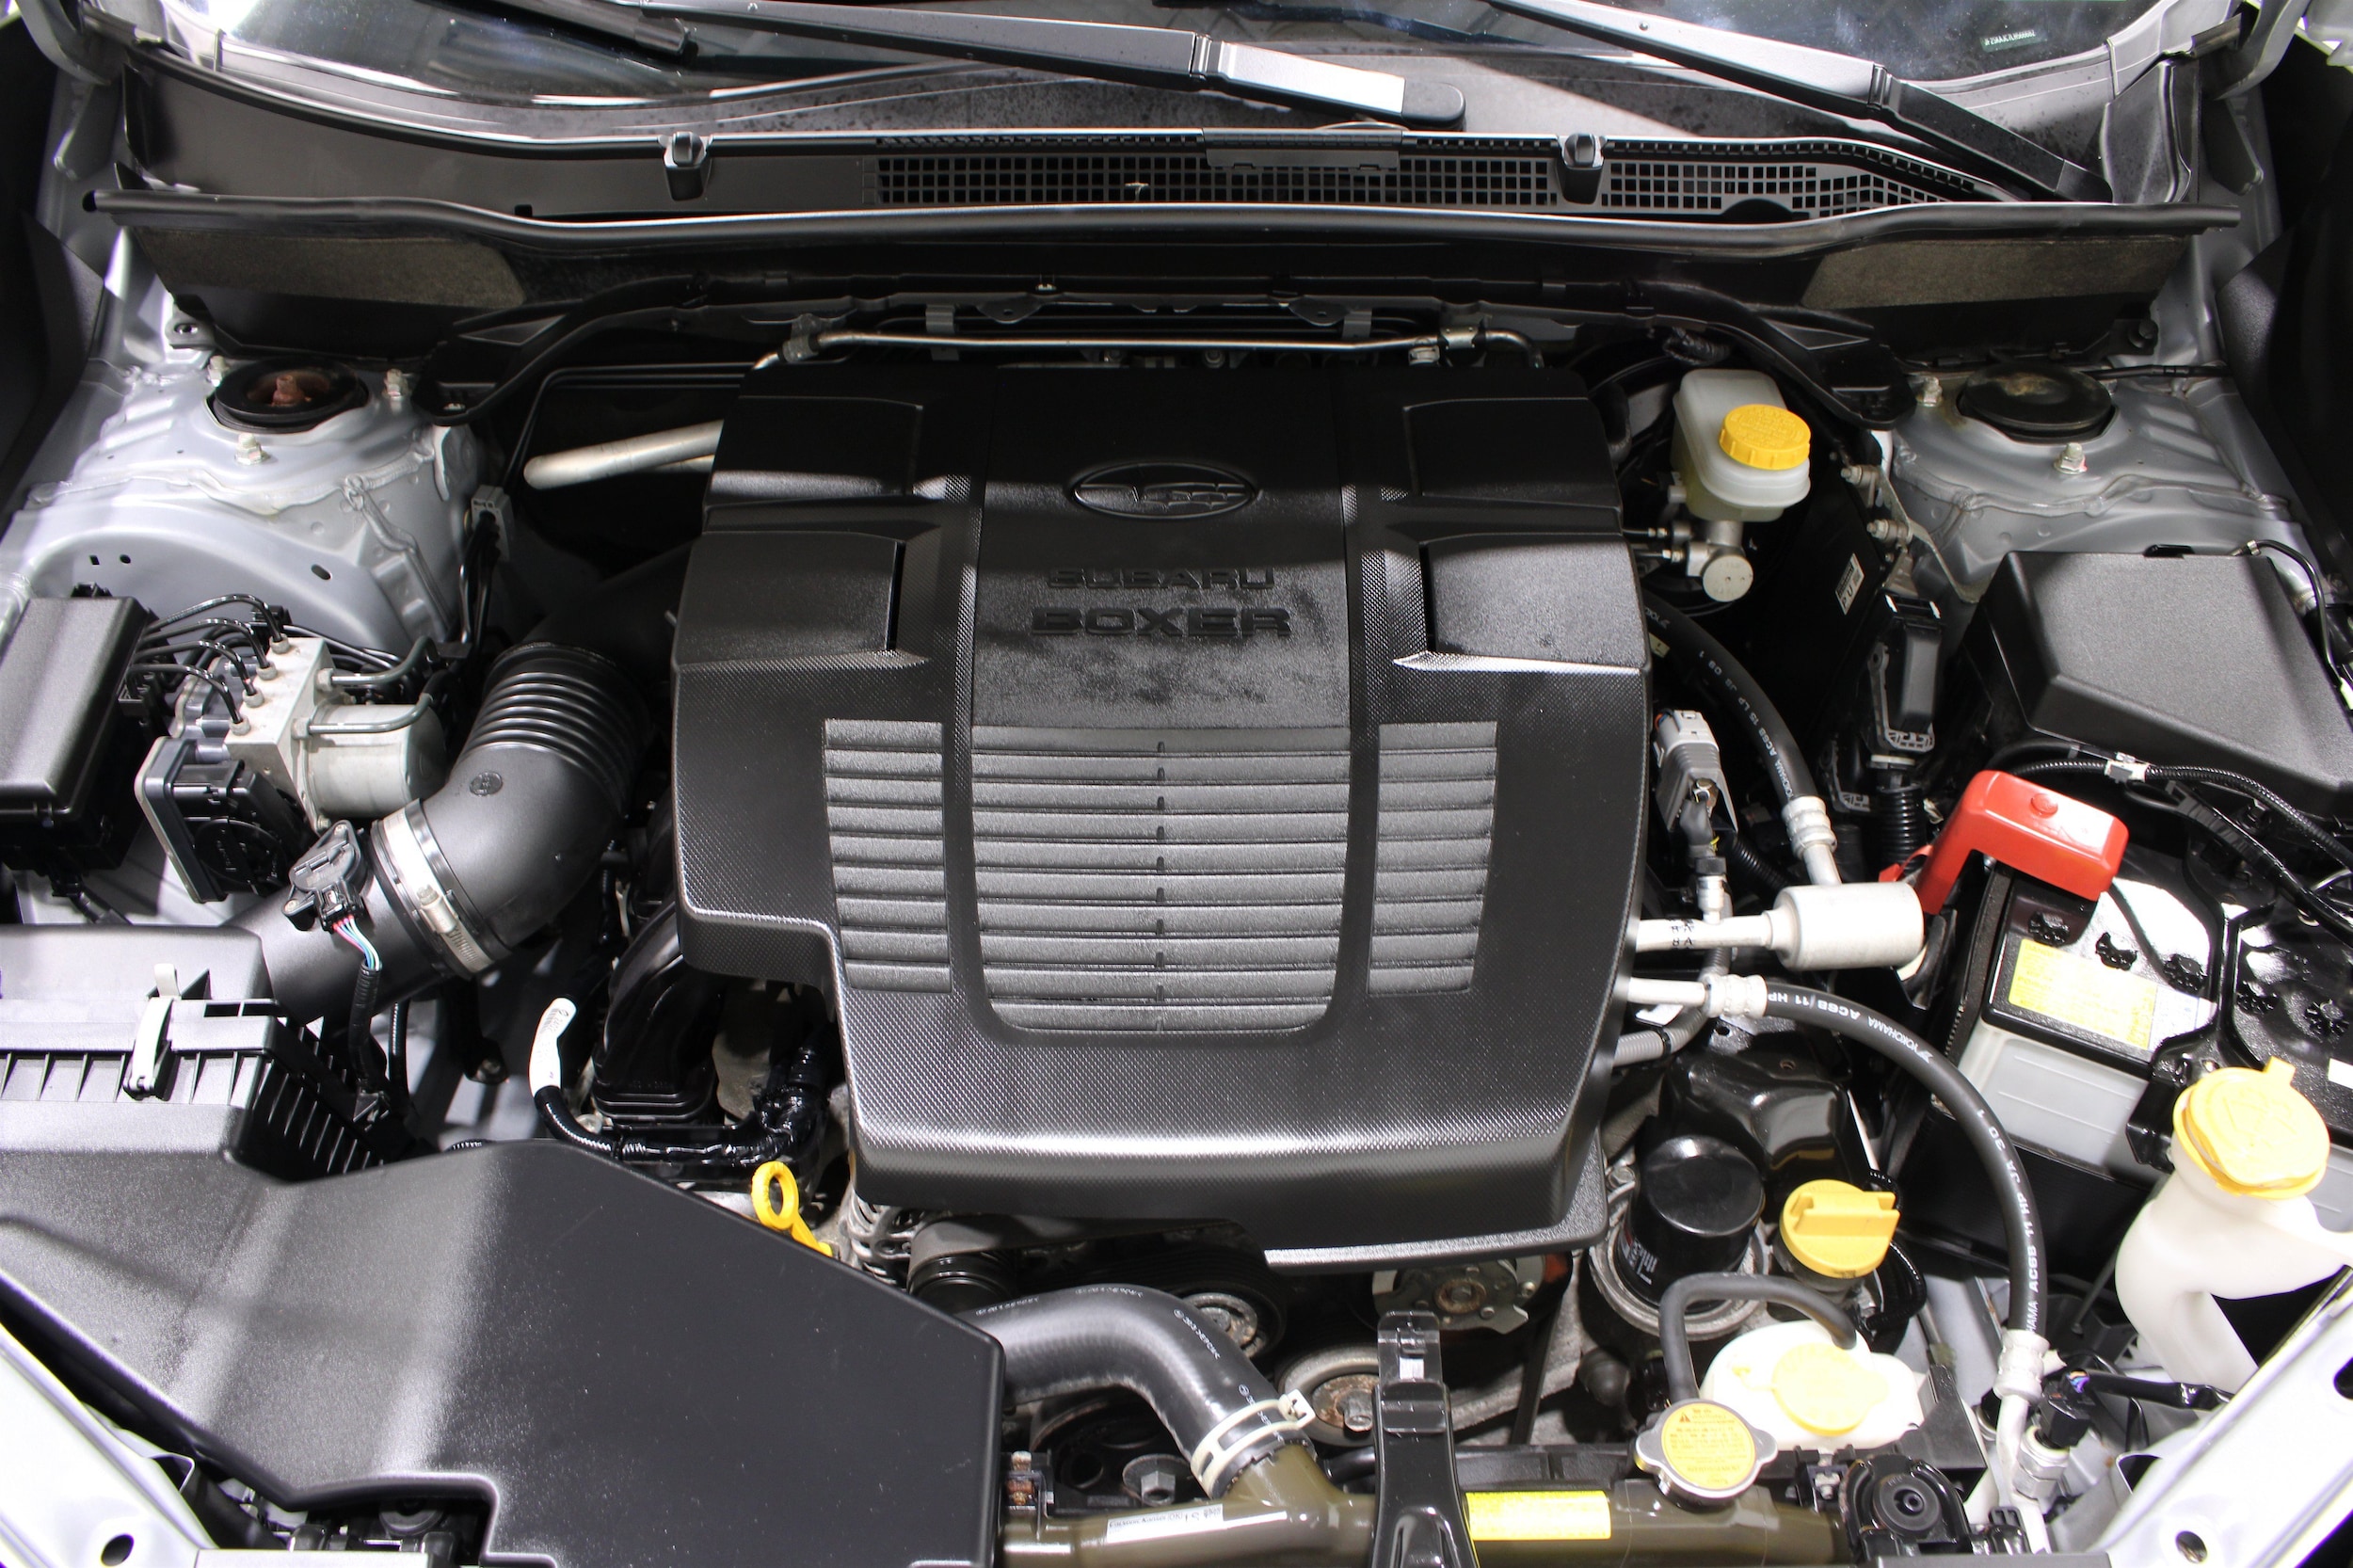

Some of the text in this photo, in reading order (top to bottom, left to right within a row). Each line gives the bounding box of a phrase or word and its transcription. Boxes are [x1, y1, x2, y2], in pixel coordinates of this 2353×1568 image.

[1048, 567, 1274, 589] SUBARU
[1032, 606, 1291, 637] BOXER
[1737, 696, 1751, 712] LP
[1749, 712, 1760, 726] 15
[1768, 992, 1788, 1003] HP
[1817, 1000, 1862, 1020] AC6B
[1867, 1015, 1919, 1053] YOKOHAMA
[1988, 1126, 2006, 1152] 30
[2006, 1159, 2021, 1184] JA
[2016, 1192, 2030, 1215] HP
[2025, 1221, 2035, 1238] 11
[2026, 1244, 2039, 1293] AC6B
